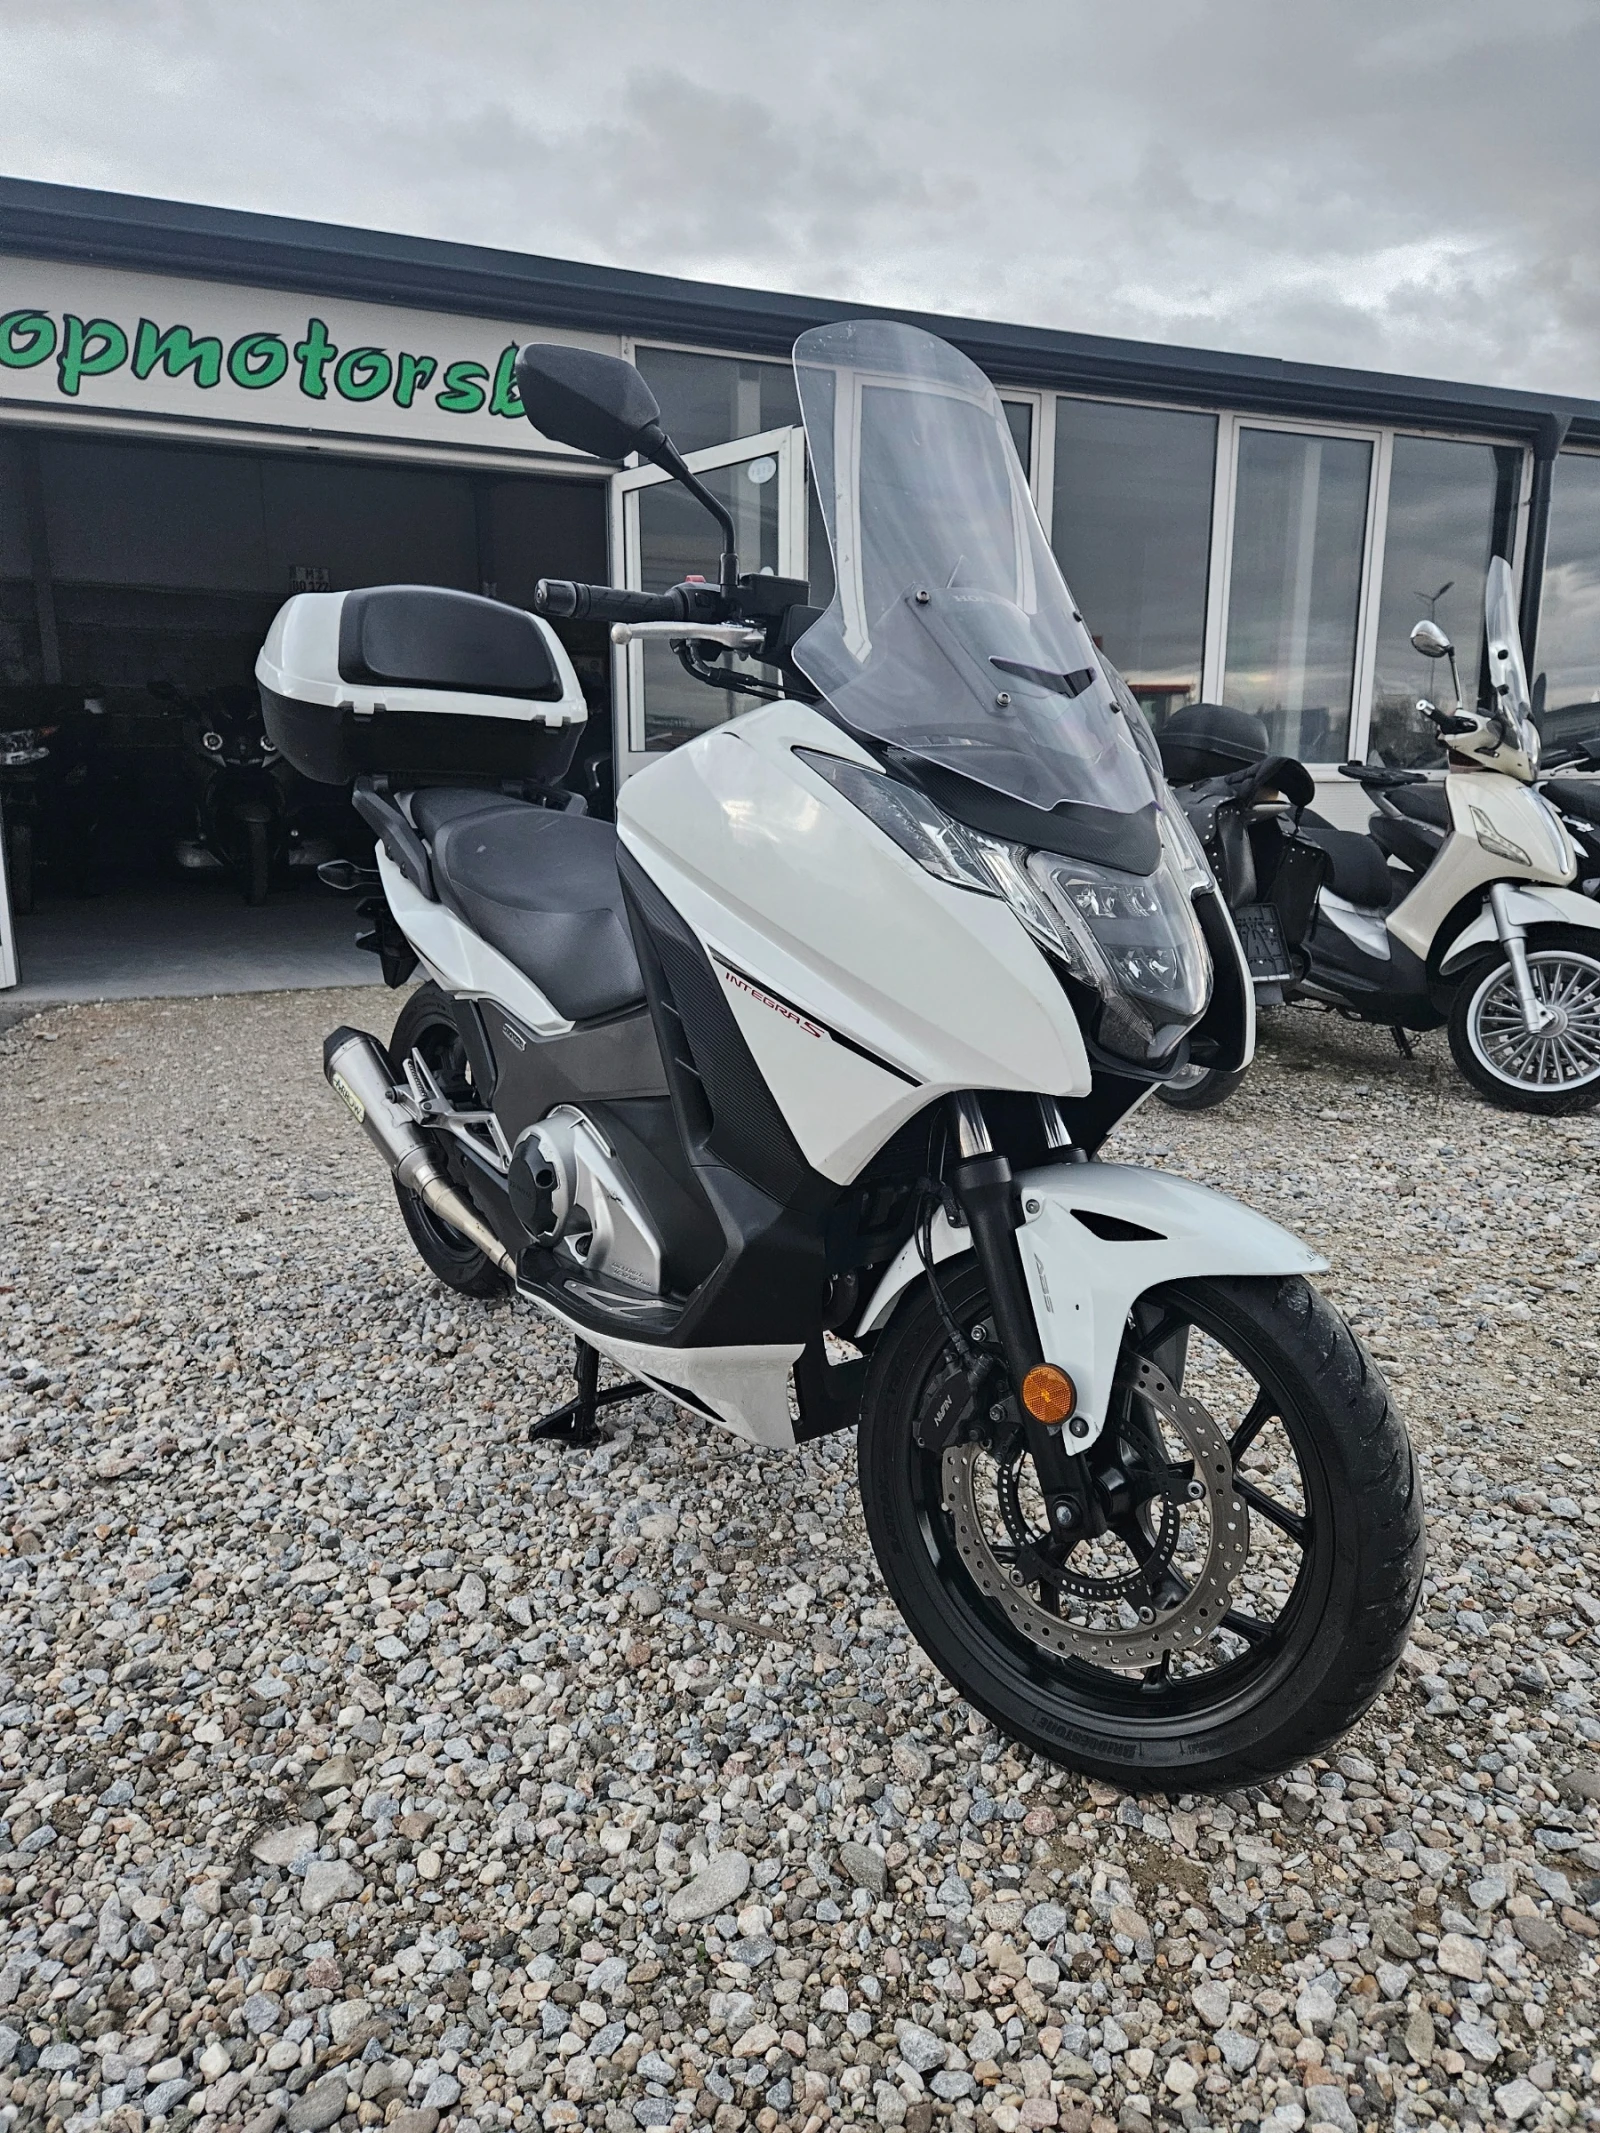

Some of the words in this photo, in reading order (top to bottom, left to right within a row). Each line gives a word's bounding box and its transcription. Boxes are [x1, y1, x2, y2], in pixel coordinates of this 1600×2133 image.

[725, 972, 801, 1025] INTEGRA
[799, 1020, 825, 1039] S
[333, 1079, 363, 1117] ARROW
[1033, 1252, 1055, 1314] ABS
